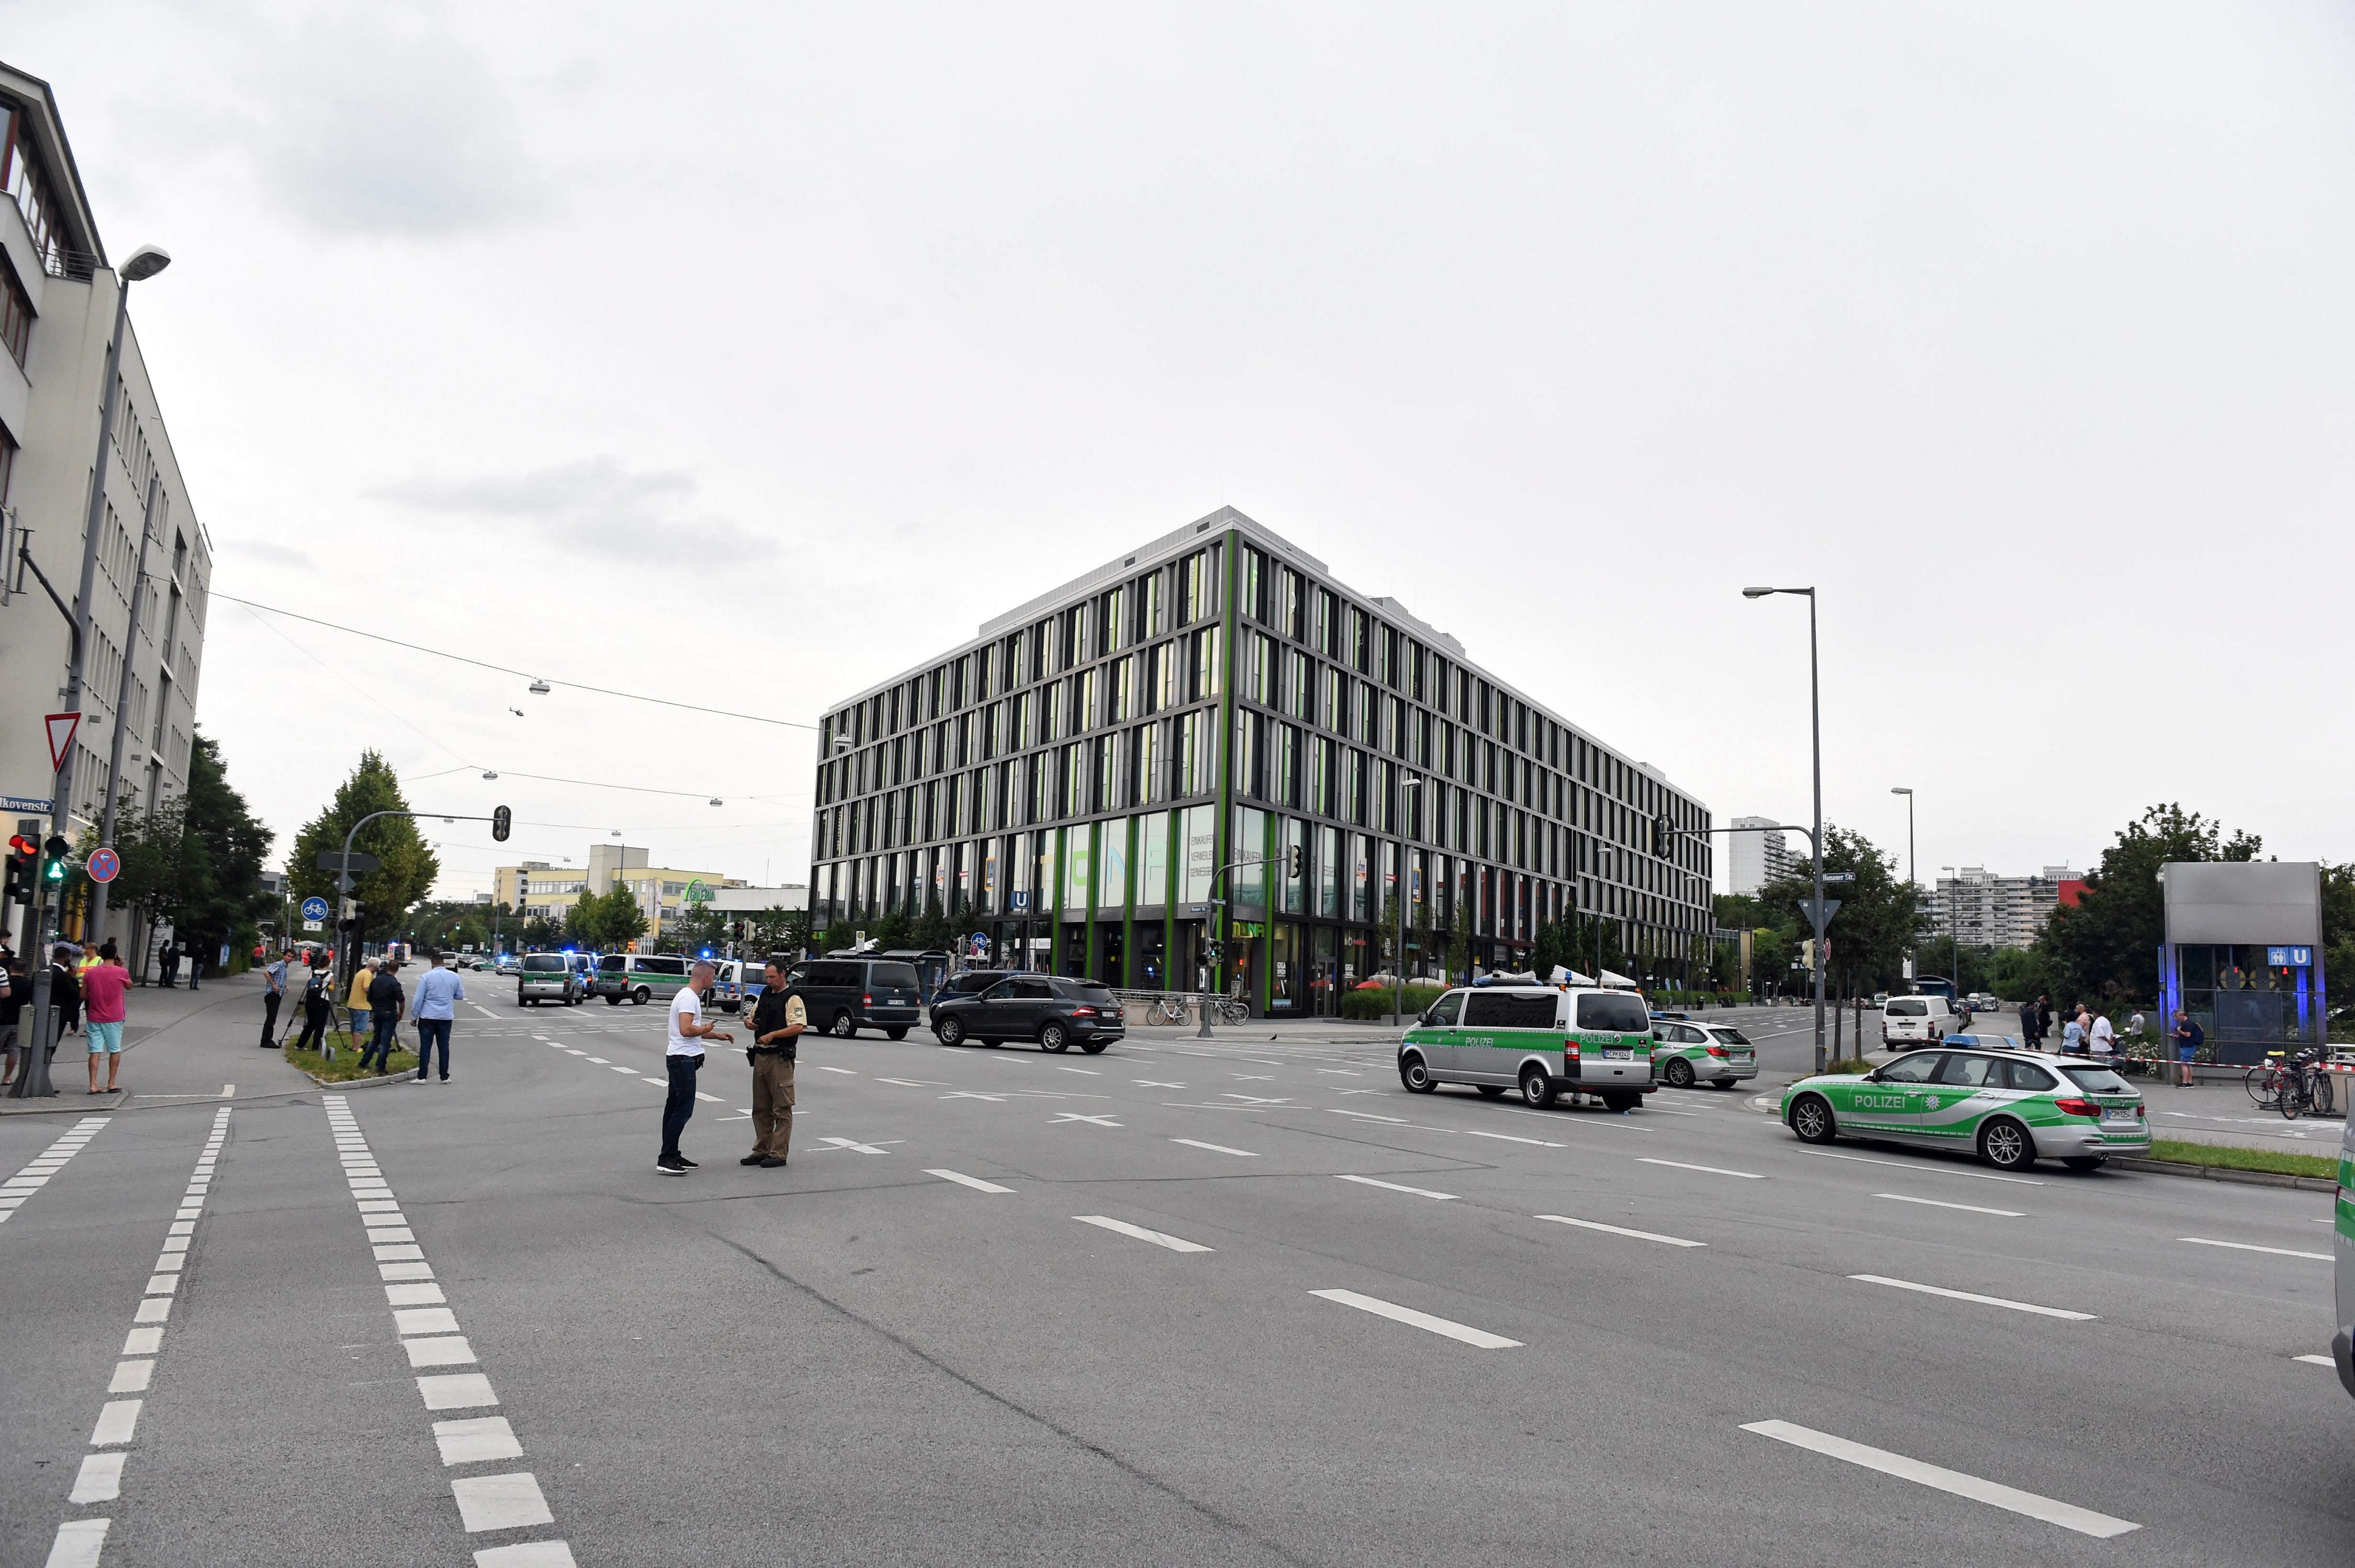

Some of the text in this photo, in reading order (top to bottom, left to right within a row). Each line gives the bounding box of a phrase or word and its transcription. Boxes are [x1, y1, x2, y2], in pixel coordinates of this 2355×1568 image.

[1016, 892, 1027, 907] U
[2293, 949, 2307, 964] U
[1277, 961, 1286, 969] GIGA
[1465, 1037, 1494, 1047] POLIZEI
[1580, 1034, 1613, 1044] POLIZEI
[1855, 1095, 1905, 1109] POLIZEI
[2100, 1098, 2120, 1106] POLIZE
